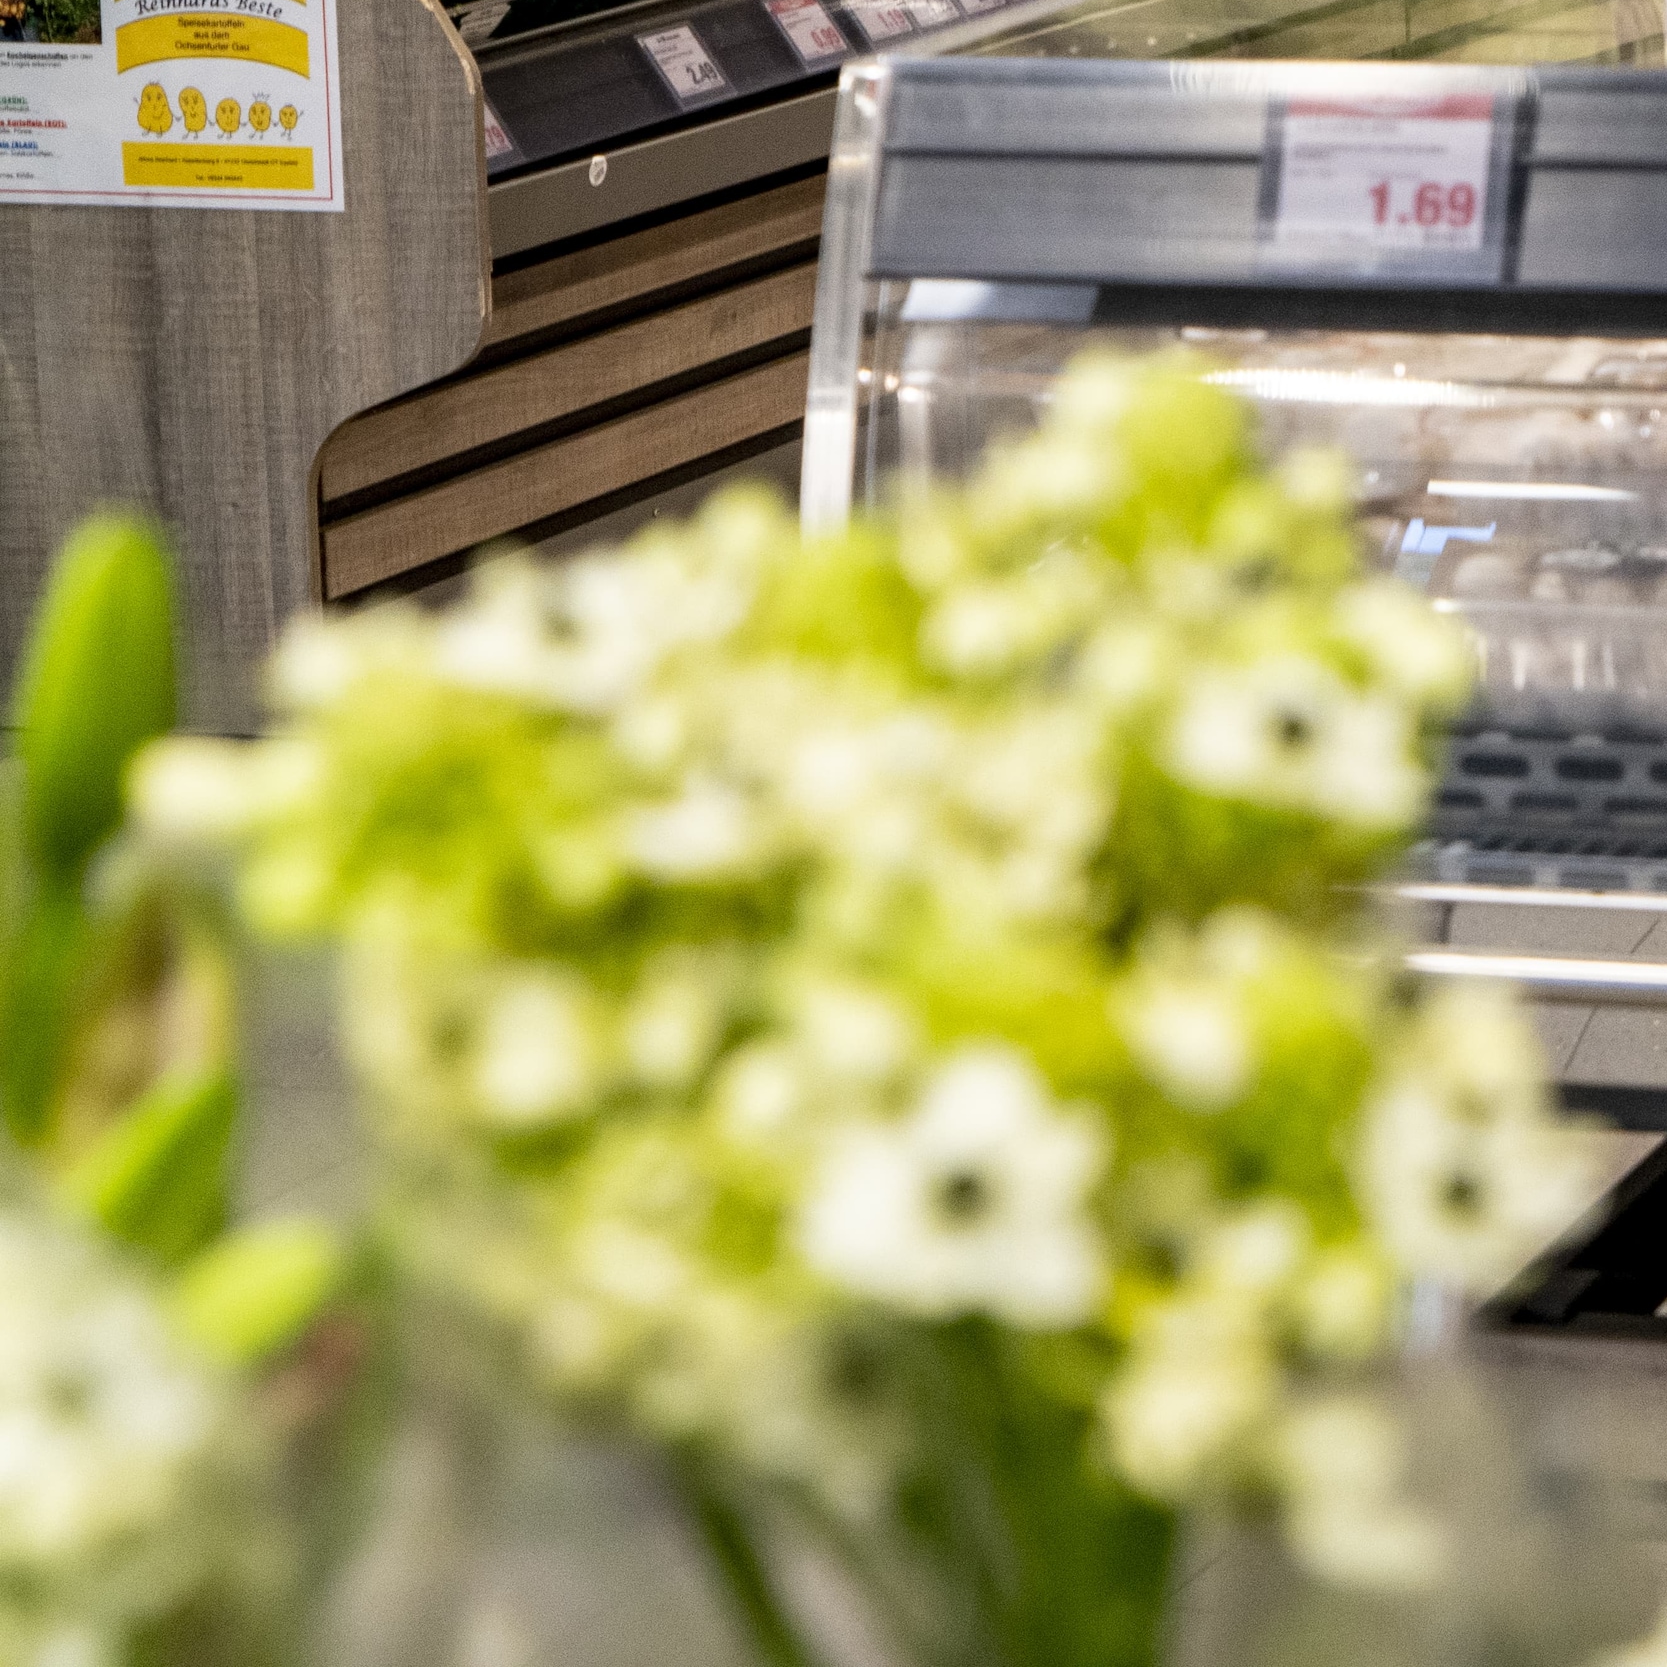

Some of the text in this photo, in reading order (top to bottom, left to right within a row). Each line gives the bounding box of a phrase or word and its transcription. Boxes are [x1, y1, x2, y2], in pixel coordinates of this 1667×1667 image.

[177, 17, 246, 30] Speisekartoffeln
[686, 61, 719, 86] 2.49
[1366, 180, 1477, 230] 1.69
